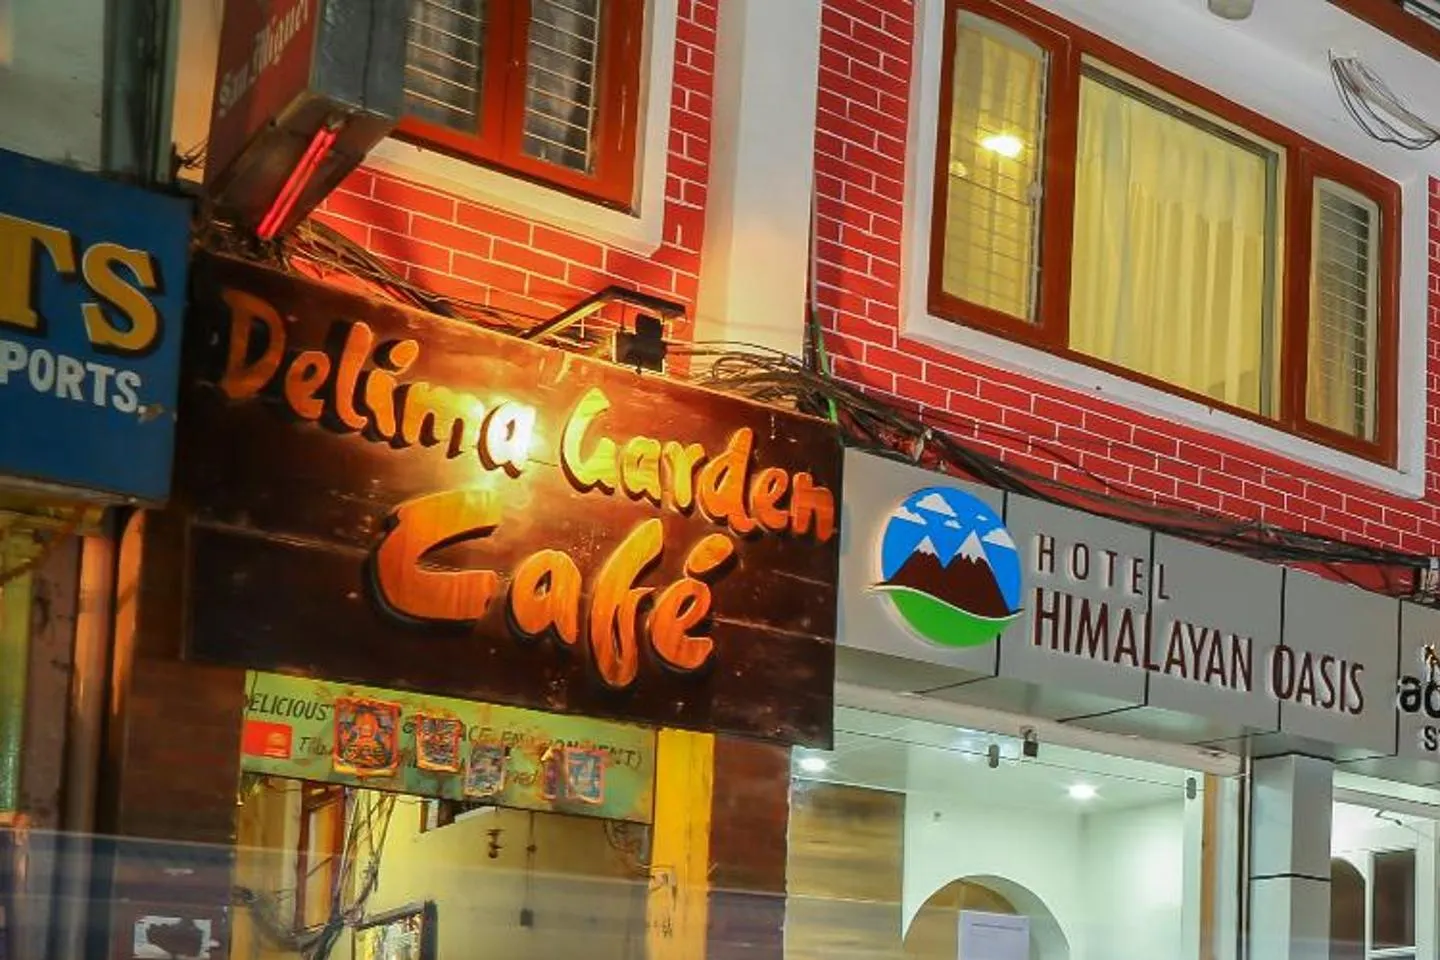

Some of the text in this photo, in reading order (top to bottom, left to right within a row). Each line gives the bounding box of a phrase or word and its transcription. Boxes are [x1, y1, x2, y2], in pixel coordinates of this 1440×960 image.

[0, 212, 157, 351] TS
[222, 288, 835, 542] Delima Garden
[376, 489, 735, 687] Café
[1036, 534, 1171, 600] HOTEL
[249, 693, 334, 722] ELICIOUS
[1032, 586, 1365, 716] HIMALAYAN OASIS
